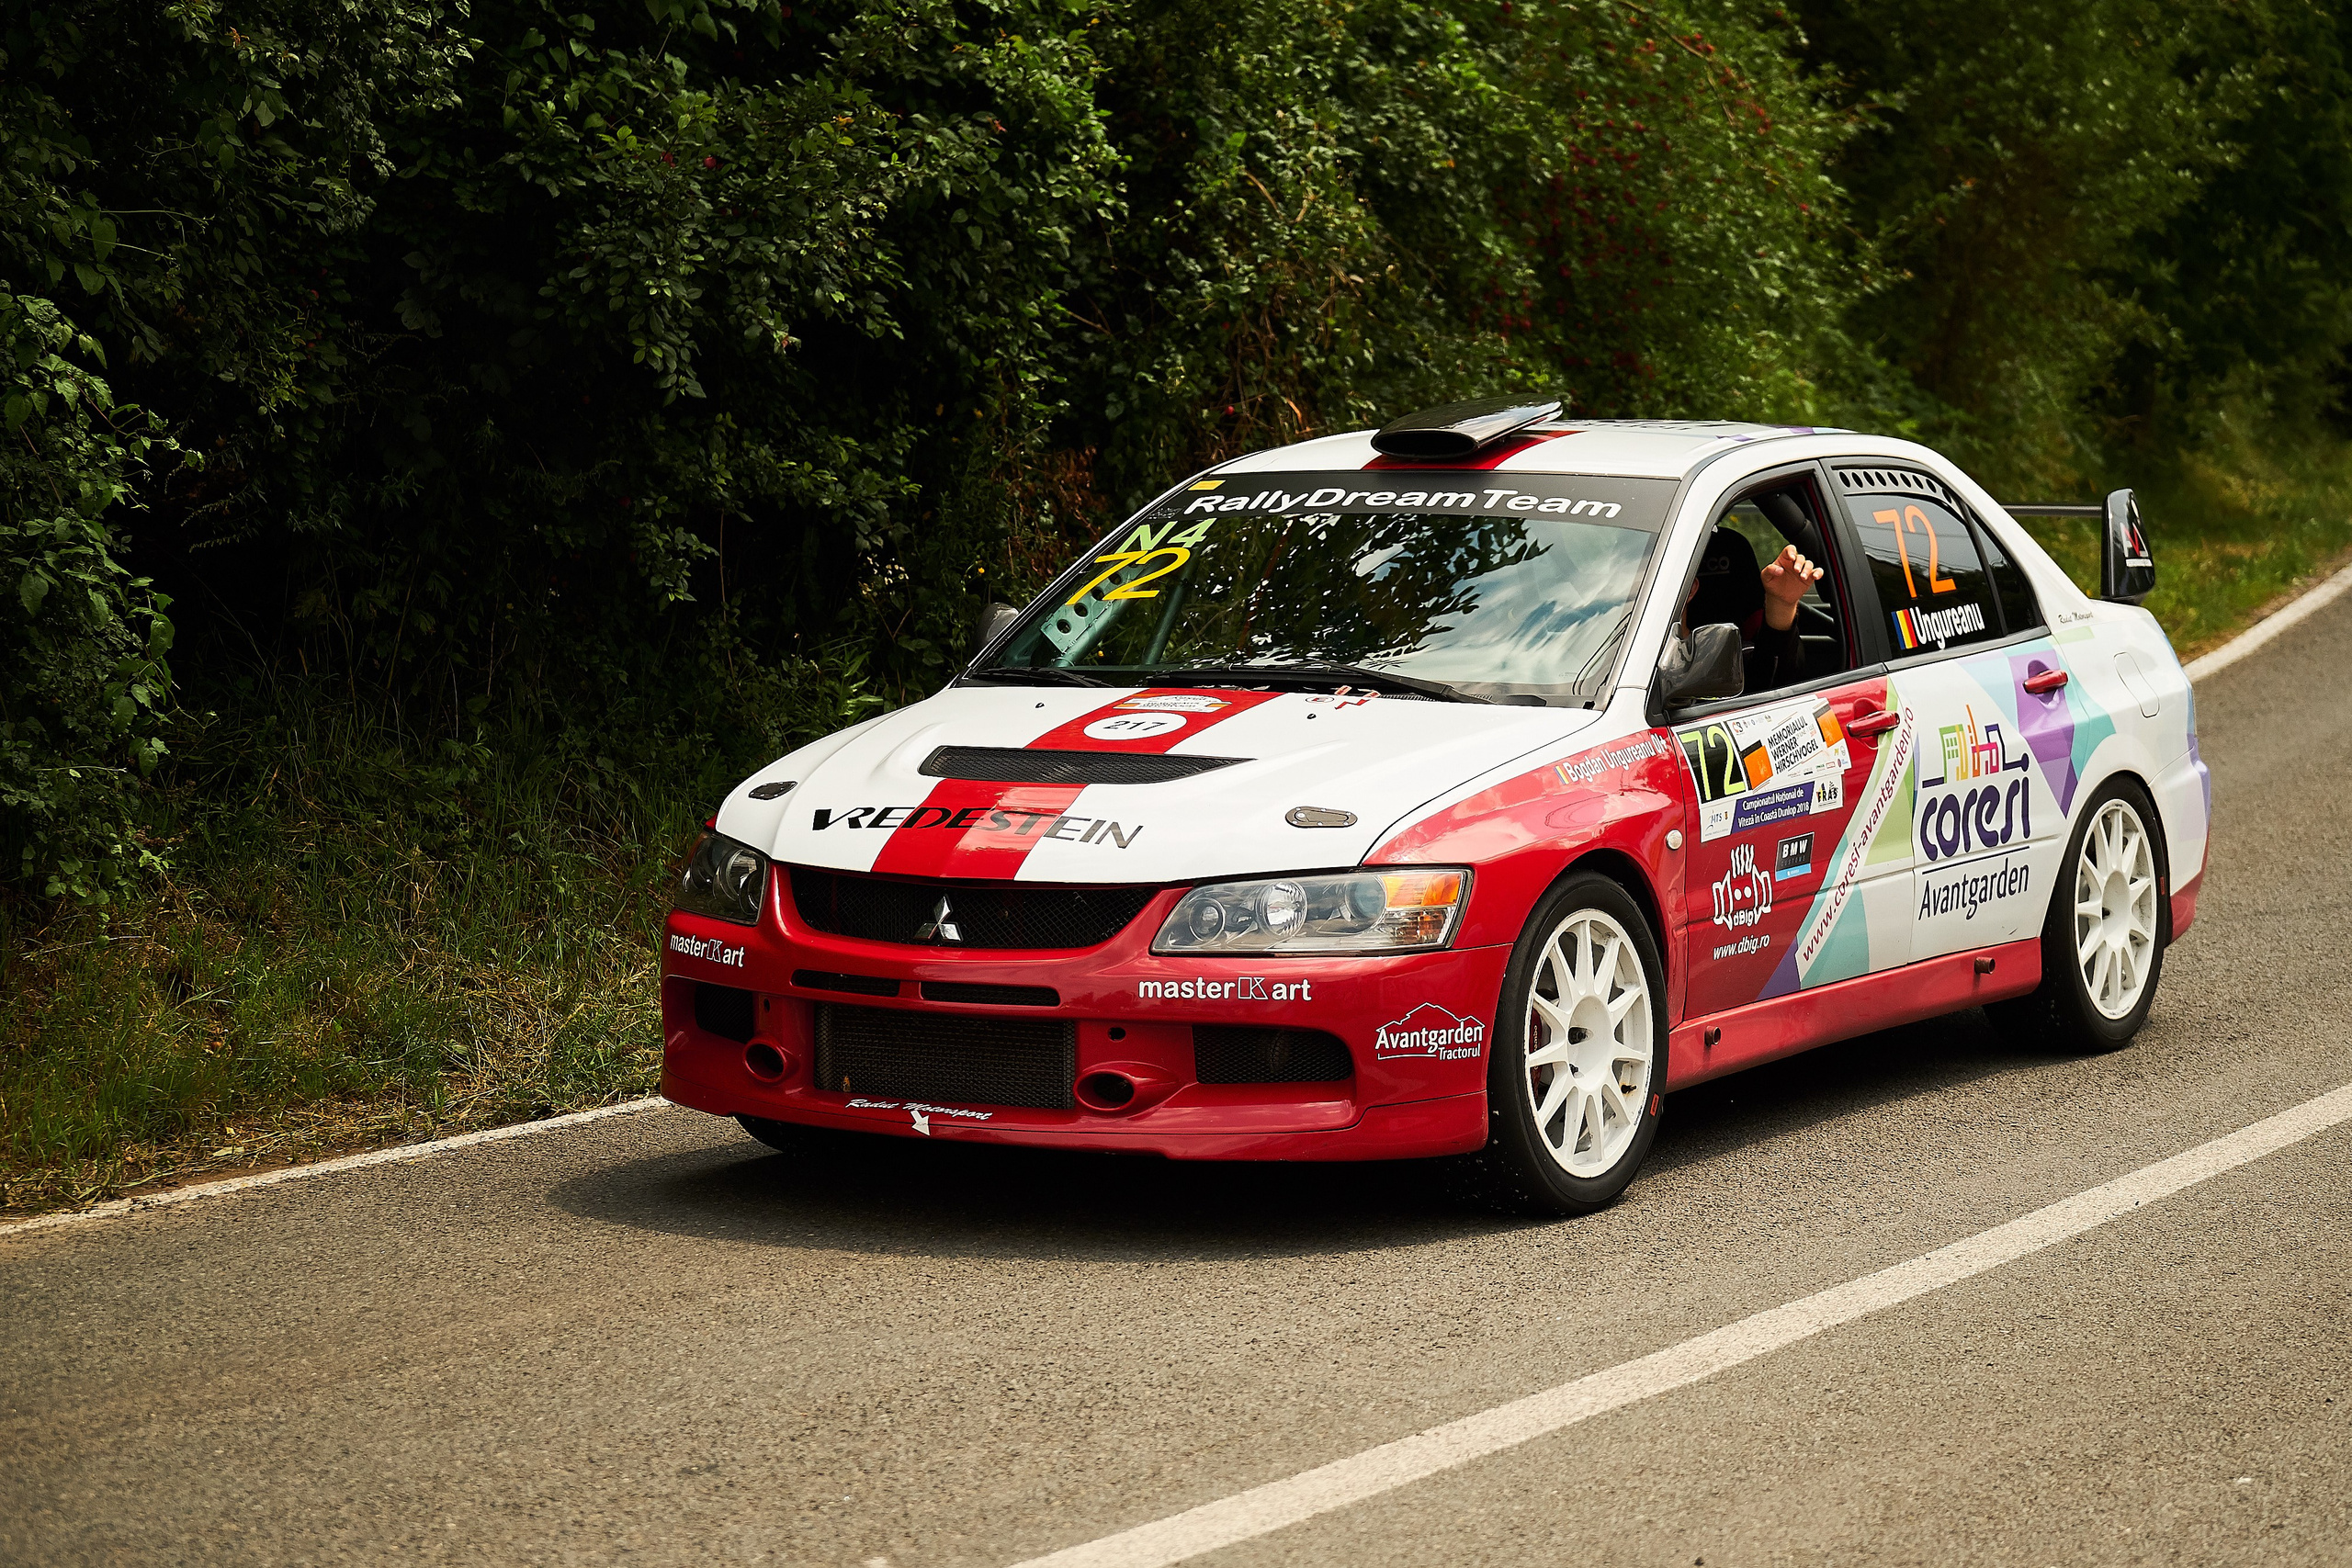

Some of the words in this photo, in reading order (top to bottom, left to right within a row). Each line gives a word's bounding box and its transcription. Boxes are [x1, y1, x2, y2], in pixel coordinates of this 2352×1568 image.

[1183, 487, 1622, 518] RallyDreamTeam
[1872, 504, 1958, 598] 72
[1065, 547, 1191, 605] 72
[1910, 602, 1985, 650] Ungureanu
[1103, 720, 1169, 731] 217
[1767, 715, 1808, 749] MEMORIALUL
[1562, 755, 1608, 783] Bogdan
[1600, 739, 1657, 771] Ungureanu
[1680, 726, 1747, 801] 72
[1770, 737, 1799, 761] WERNER
[1774, 739, 1819, 774] HIRSCHVOGEL
[1742, 793, 1775, 811] Campionatul
[1797, 786, 1804, 798] de
[1777, 805, 1797, 818] Dunlop
[1796, 802, 1810, 814] 2018
[1817, 787, 1838, 804] FRAS
[1919, 753, 2032, 862] coresi
[812, 806, 1144, 849] VREDESTEIN
[1803, 706, 1915, 962] www.coresi-avantgarden.ro
[1781, 839, 1808, 859] BMW
[1918, 858, 2030, 921] Avantgarden
[1713, 934, 1770, 961] www.dbig.ro
[1374, 1021, 1484, 1053] Avantgarden
[1439, 1043, 1481, 1061] Tractorul
[902, 1102, 993, 1121] Motorsport
